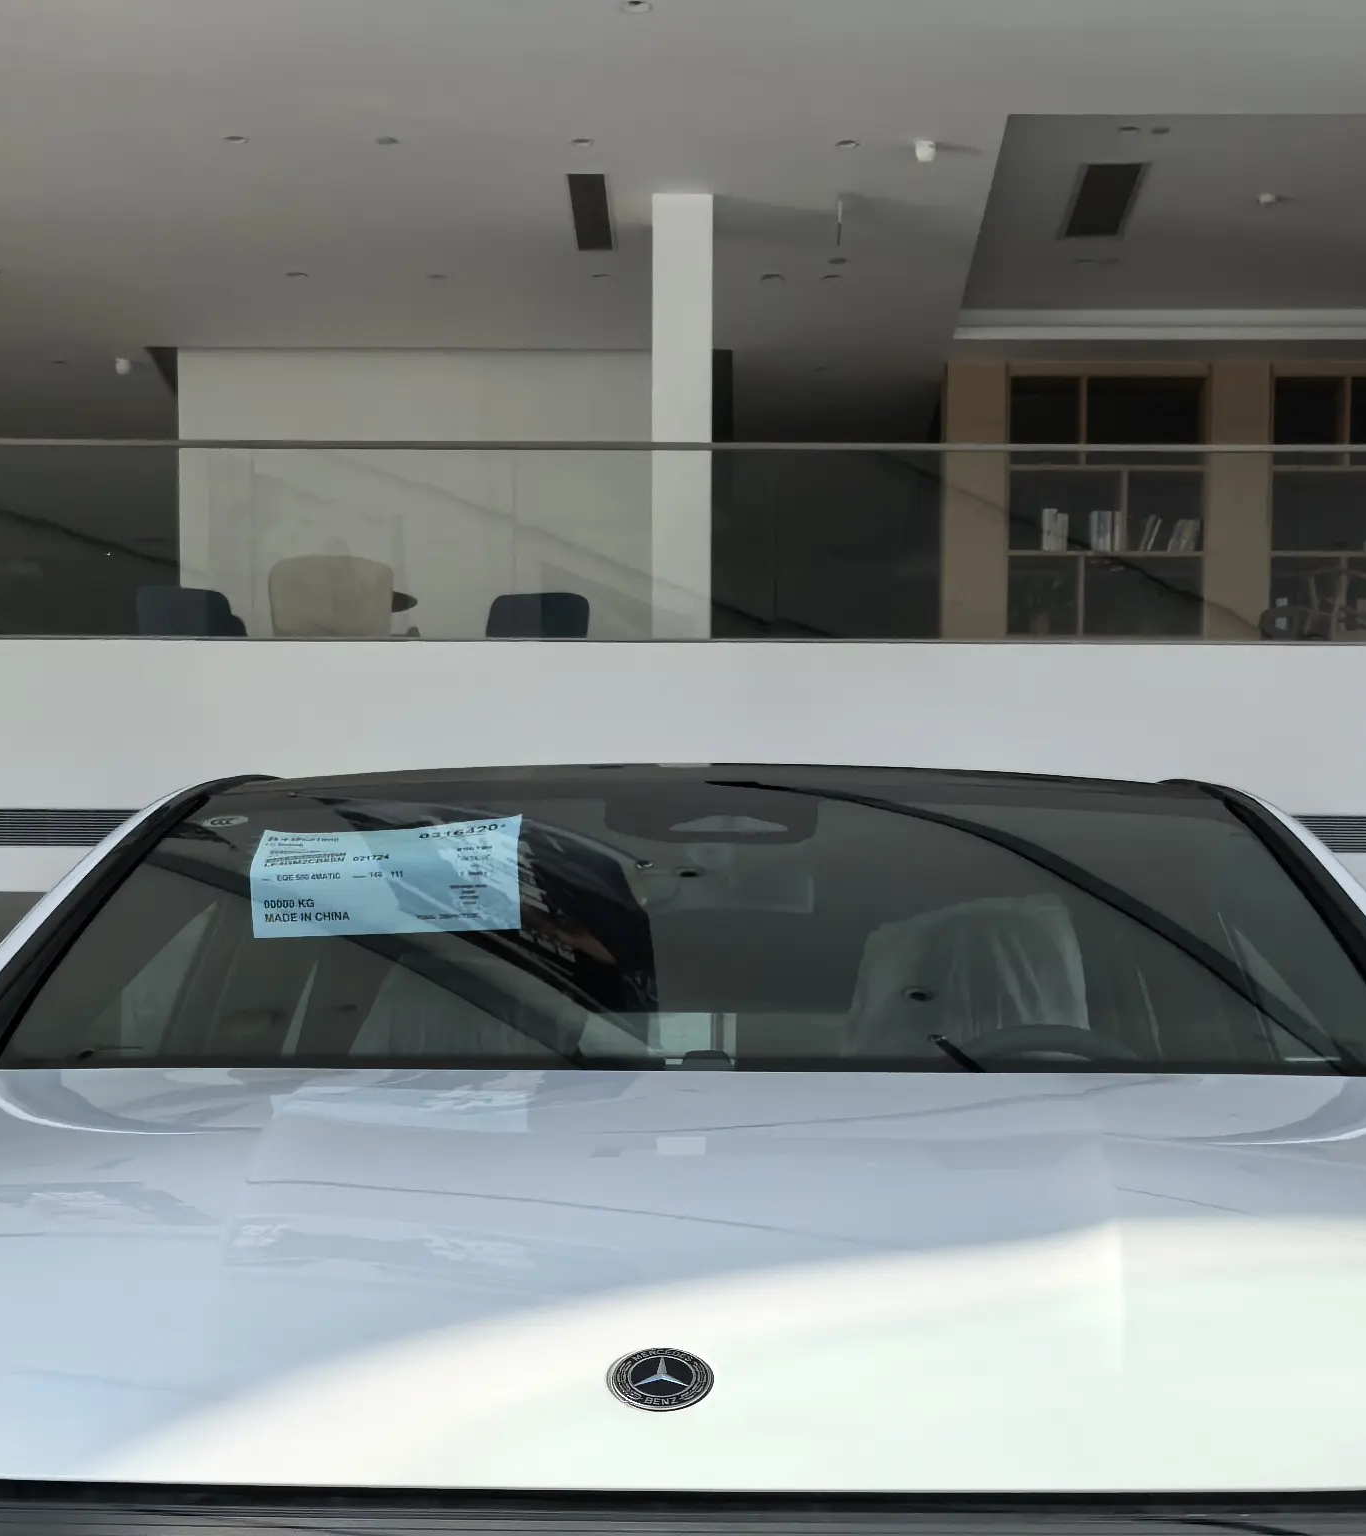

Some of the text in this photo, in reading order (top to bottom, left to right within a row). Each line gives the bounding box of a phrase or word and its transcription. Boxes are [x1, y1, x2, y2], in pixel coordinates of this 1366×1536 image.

[298, 898, 316, 908] KG
[264, 911, 351, 923] MADE IN CHINA
[643, 1396, 678, 1406] BENZ
